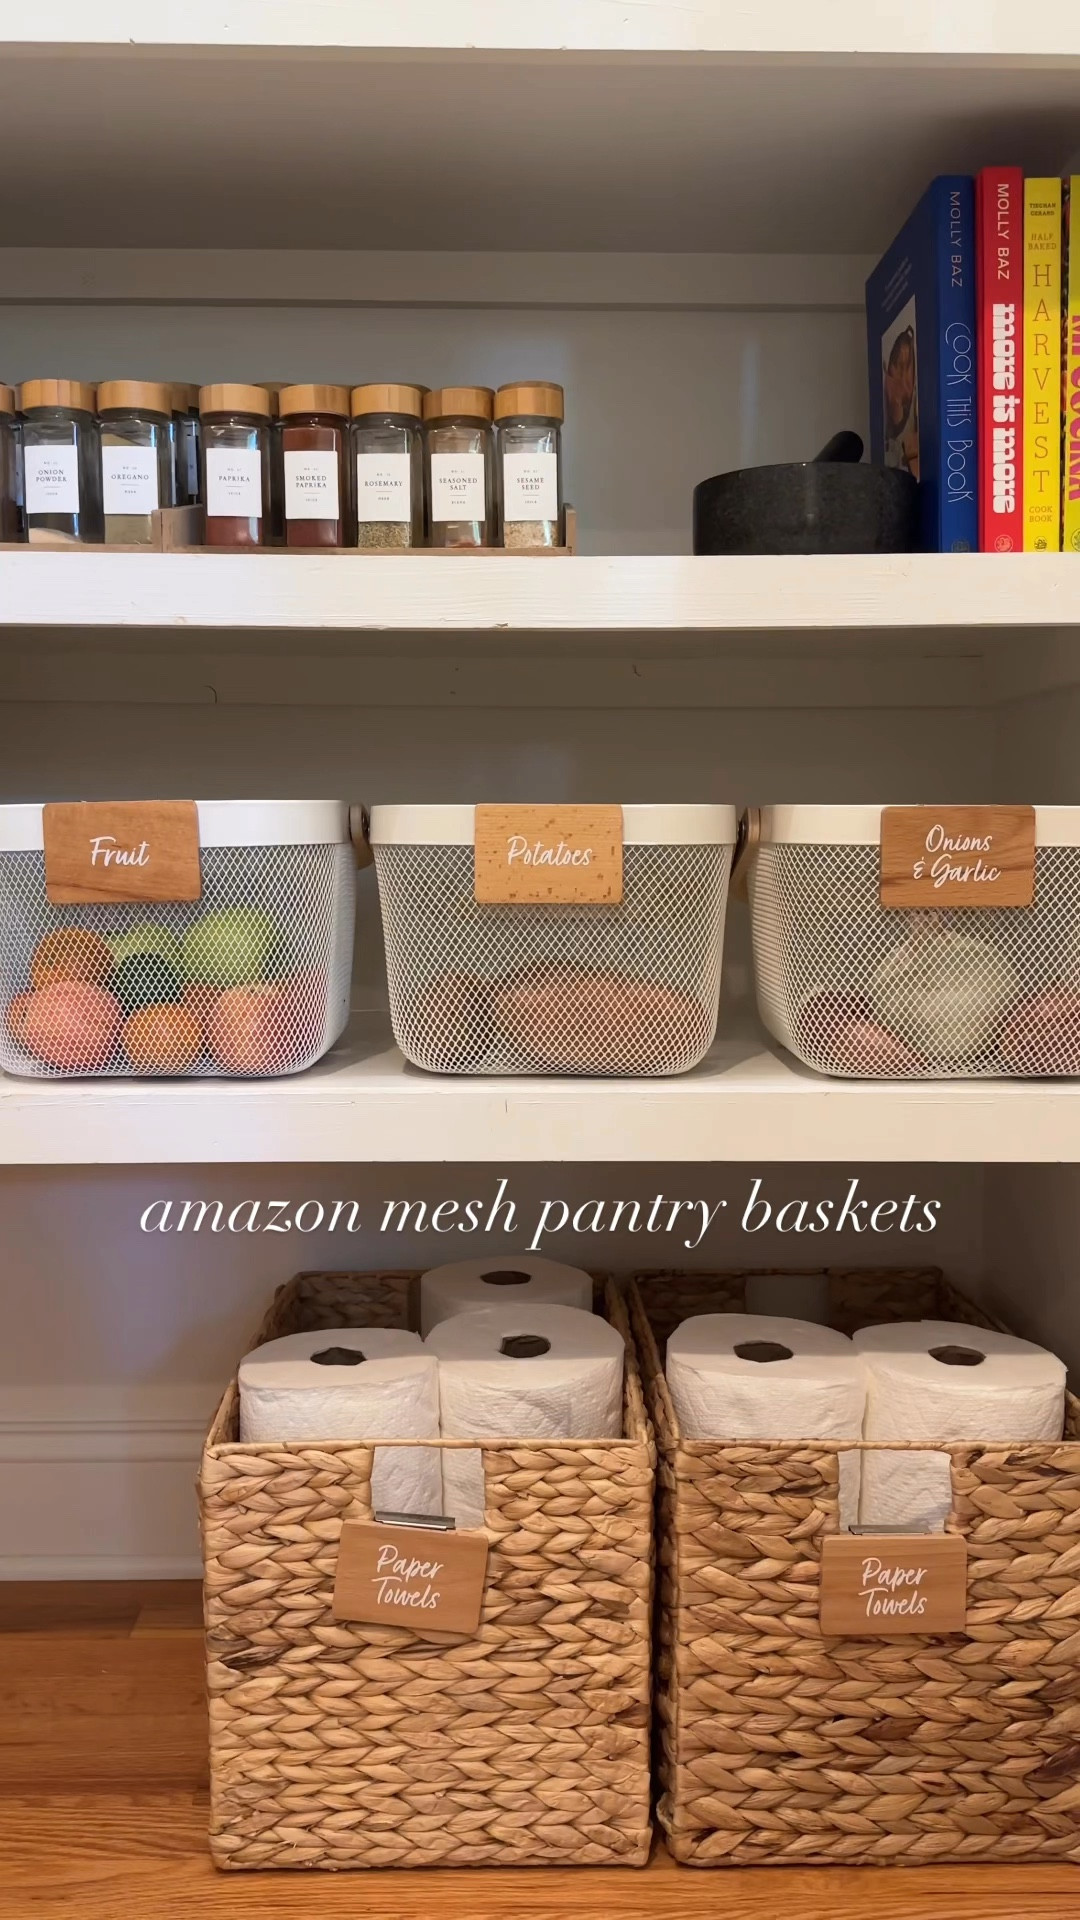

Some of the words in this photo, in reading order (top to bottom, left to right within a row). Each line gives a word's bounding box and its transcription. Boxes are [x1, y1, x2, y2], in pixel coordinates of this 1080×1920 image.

[949, 191, 963, 248] MOLLY
[997, 183, 1010, 239] MOLLY
[1028, 242, 1057, 251] BAKED
[1031, 233, 1054, 242] HALF
[951, 254, 965, 288] BAZ
[997, 247, 1010, 280] BAZ
[945, 322, 972, 385] COOK
[993, 303, 1016, 390] more
[993, 394, 1021, 423] is
[947, 439, 974, 503] BOOK
[993, 428, 1016, 514] more
[1028, 505, 1053, 514] COOK
[1028, 514, 1053, 523] BOOK
[90, 835, 150, 867] Fruit
[506, 835, 597, 867] Potatoes
[925, 824, 993, 853] Onions
[930, 853, 1002, 889] Garlic
[376, 1544, 445, 1582] Paper
[862, 1557, 928, 1592] Paper
[371, 1576, 441, 1609] Towels
[858, 1587, 928, 1617] Towels
